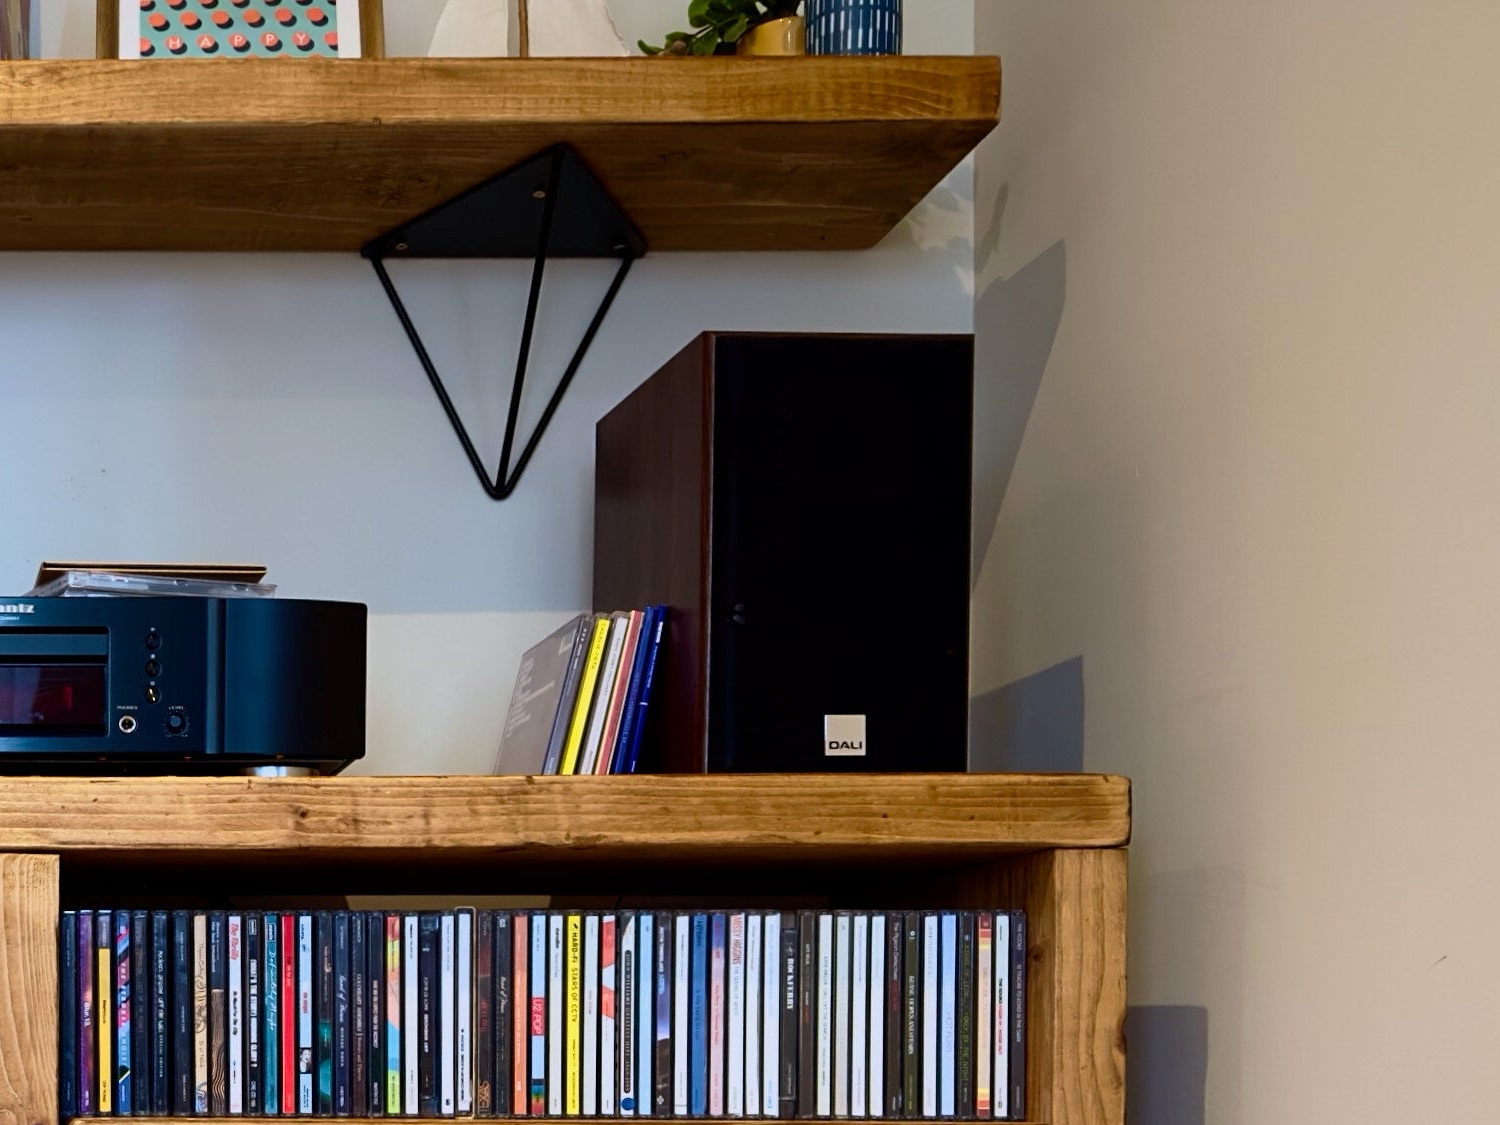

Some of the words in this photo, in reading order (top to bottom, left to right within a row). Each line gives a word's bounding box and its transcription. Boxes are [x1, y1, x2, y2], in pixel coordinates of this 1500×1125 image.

[829, 741, 862, 750] DALI
[231, 924, 239, 936] The
[733, 916, 741, 937] MISSY
[732, 939, 741, 965] HIGGINS
[533, 999, 541, 1012] U2
[572, 993, 578, 1002] OF
[267, 1003, 276, 1031] Maybe
[533, 1014, 542, 1034] POP
[478, 1081, 490, 1114] TEXAS
